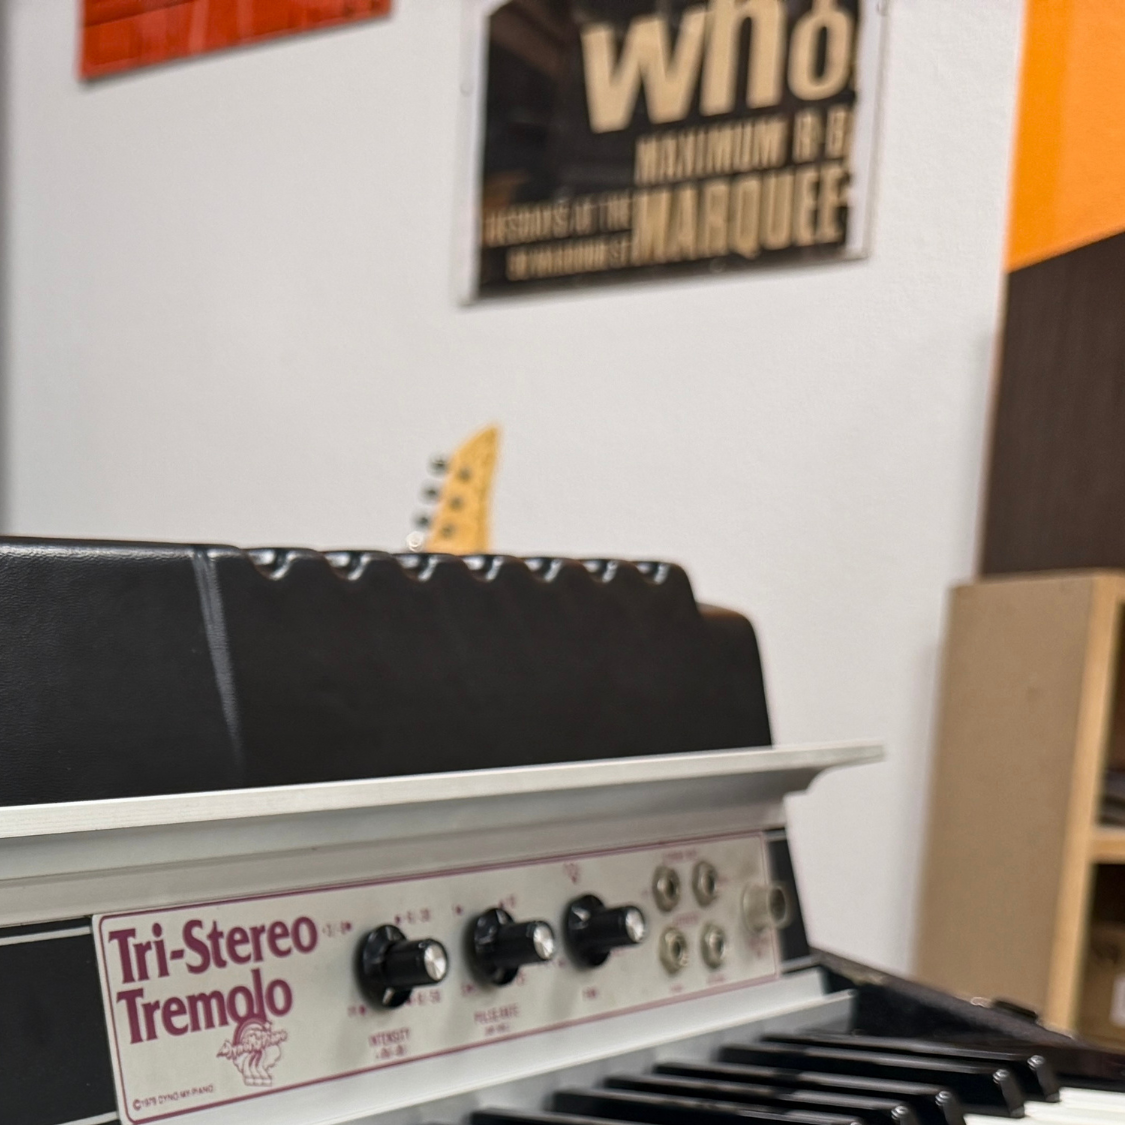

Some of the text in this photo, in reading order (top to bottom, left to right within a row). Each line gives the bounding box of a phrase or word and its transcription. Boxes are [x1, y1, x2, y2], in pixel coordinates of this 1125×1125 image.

[634, 113, 788, 187] MAXIMUM
[631, 163, 849, 267] MARQUEE
[108, 916, 318, 984] Tri-Stereo
[116, 968, 293, 1044] Tremolo
